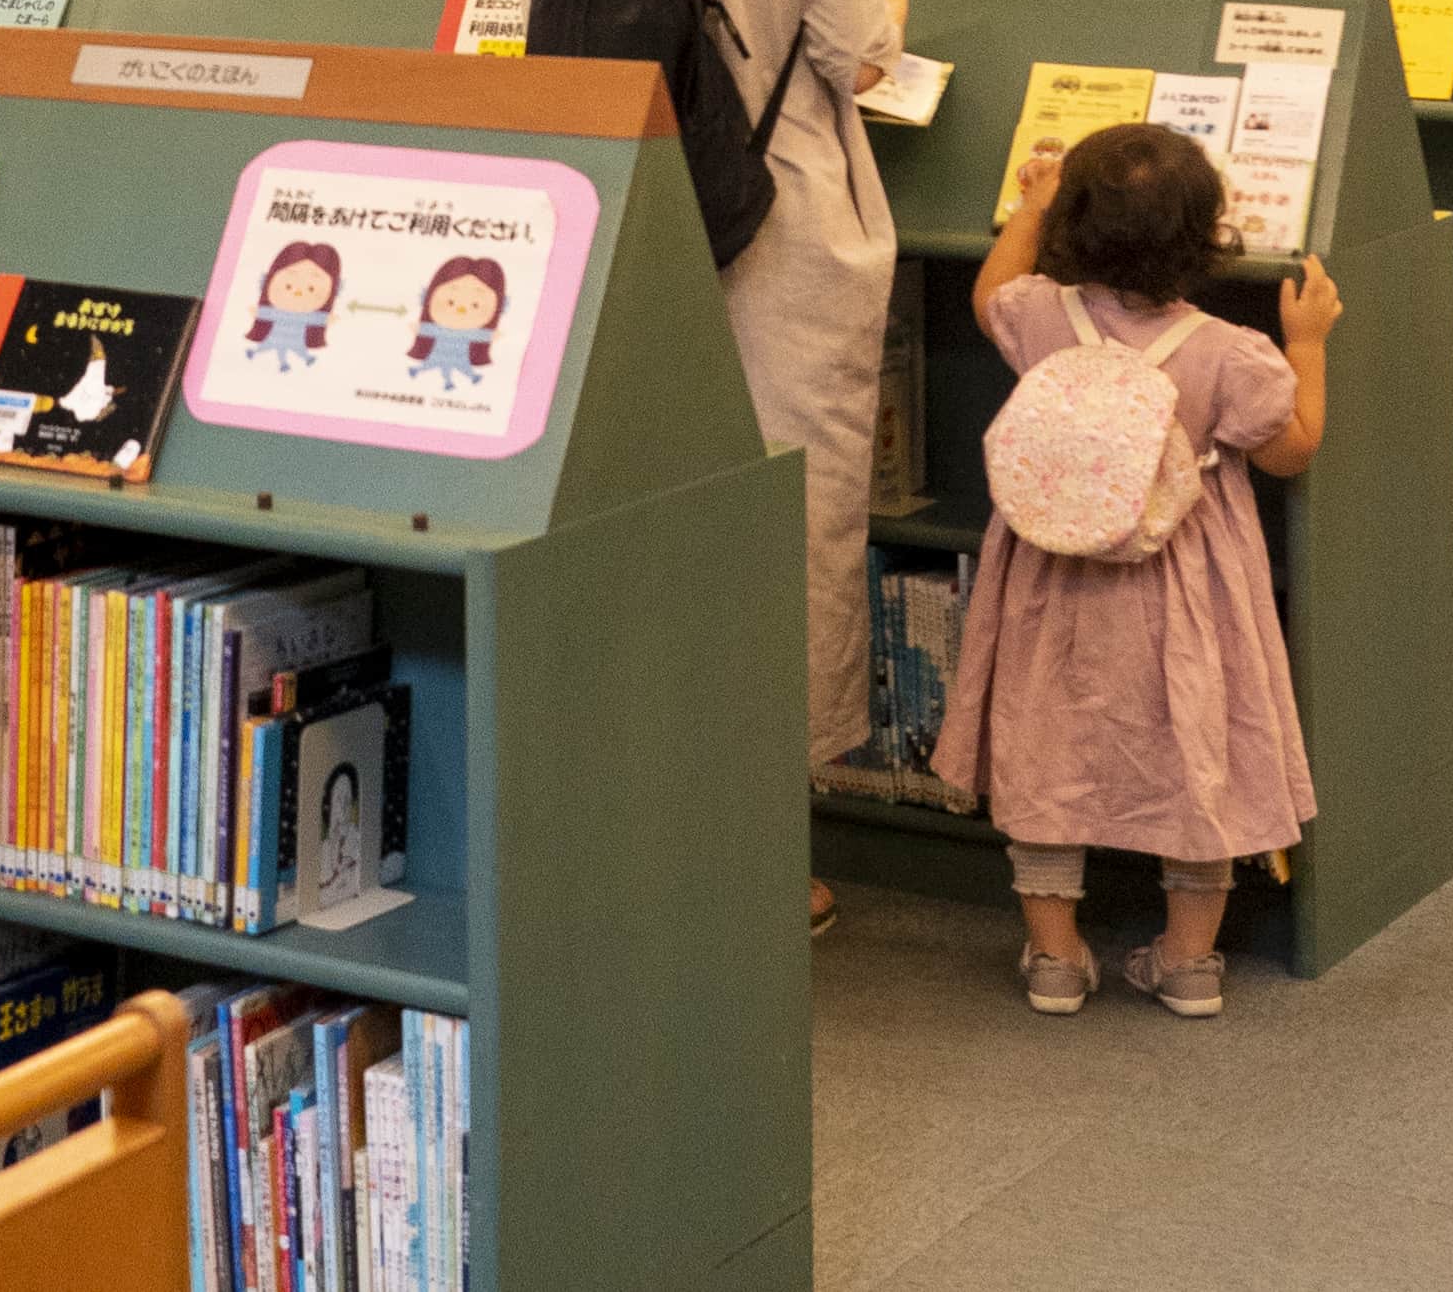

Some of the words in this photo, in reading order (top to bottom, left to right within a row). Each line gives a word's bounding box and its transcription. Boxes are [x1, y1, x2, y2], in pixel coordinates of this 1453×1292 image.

[118, 57, 261, 88] がいこくのえほん
[266, 200, 536, 245] 間隔をあけてご利用ください。
